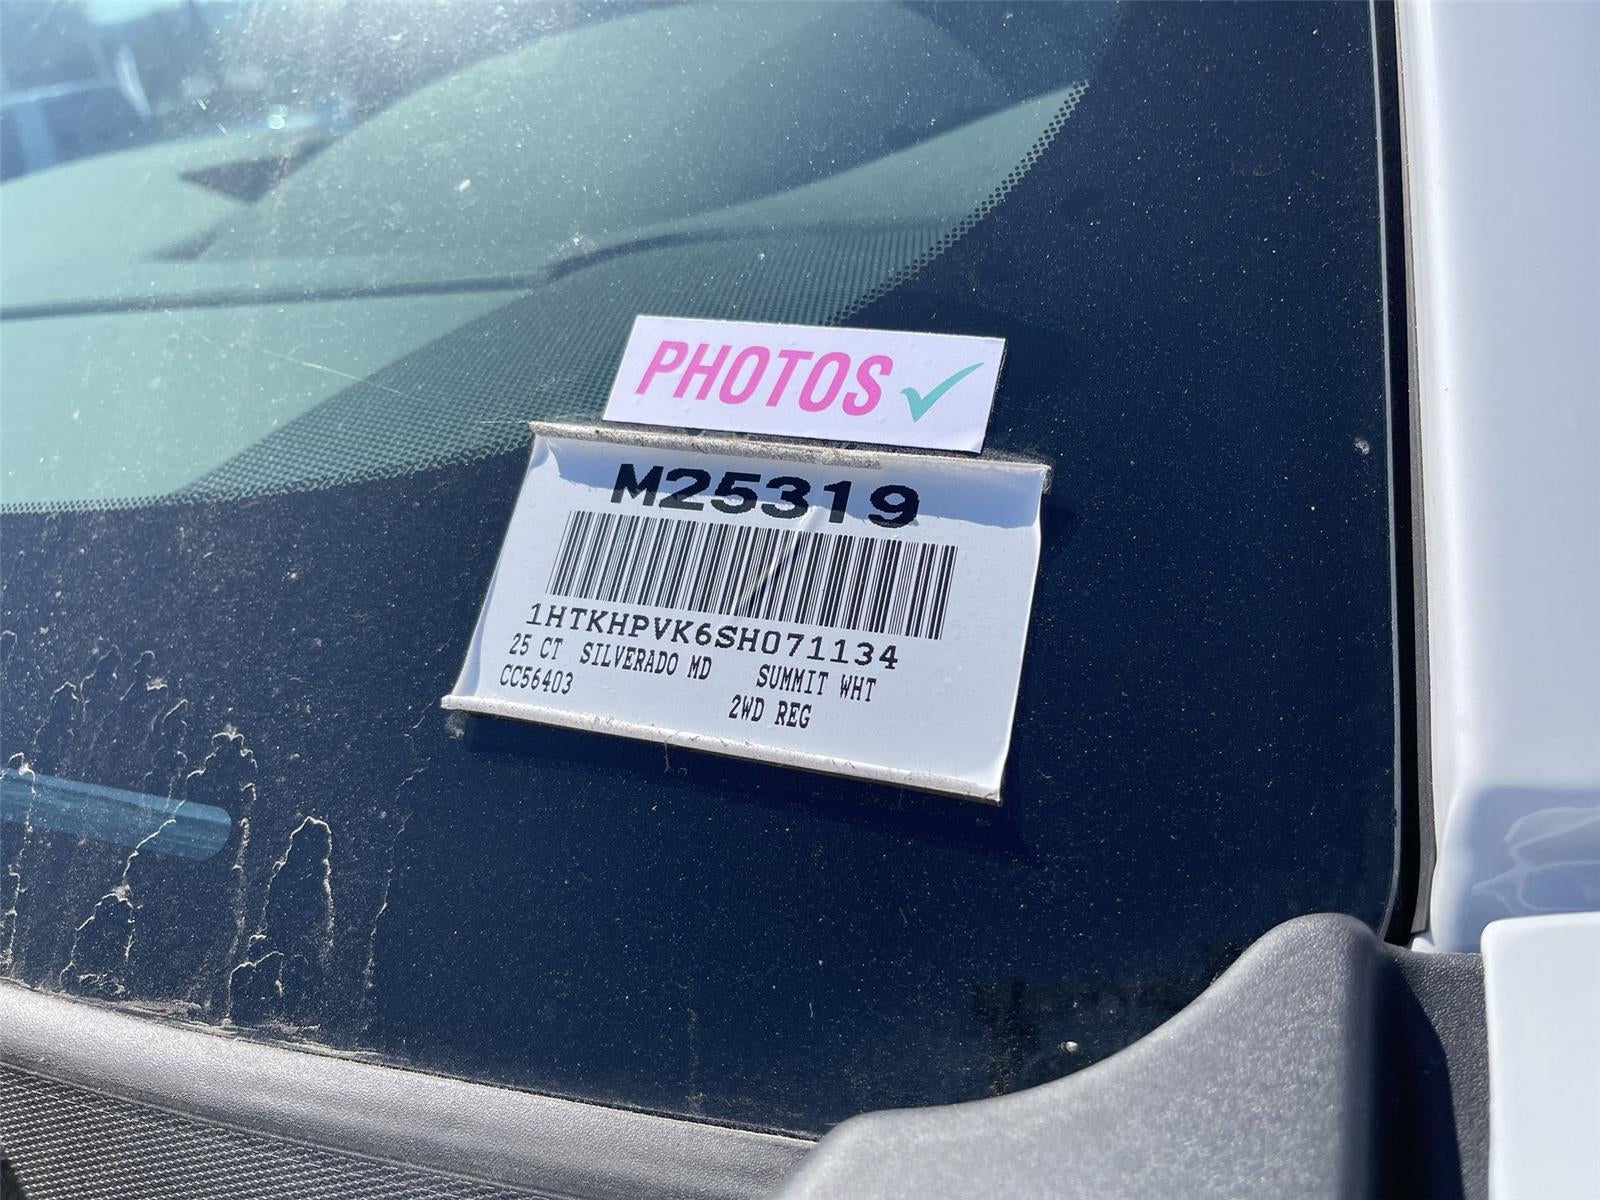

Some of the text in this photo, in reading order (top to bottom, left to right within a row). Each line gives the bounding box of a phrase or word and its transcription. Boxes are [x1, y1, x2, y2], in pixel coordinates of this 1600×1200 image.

[635, 340, 894, 416] PHOTOS
[610, 463, 920, 528] M25319
[508, 632, 877, 702] 25 CT SILVERADO MD SUMMIT WHT
[525, 602, 899, 669] 1HTKHPVK6SH071134
[499, 663, 574, 695] CC56403
[728, 694, 812, 729] 2WD REG
